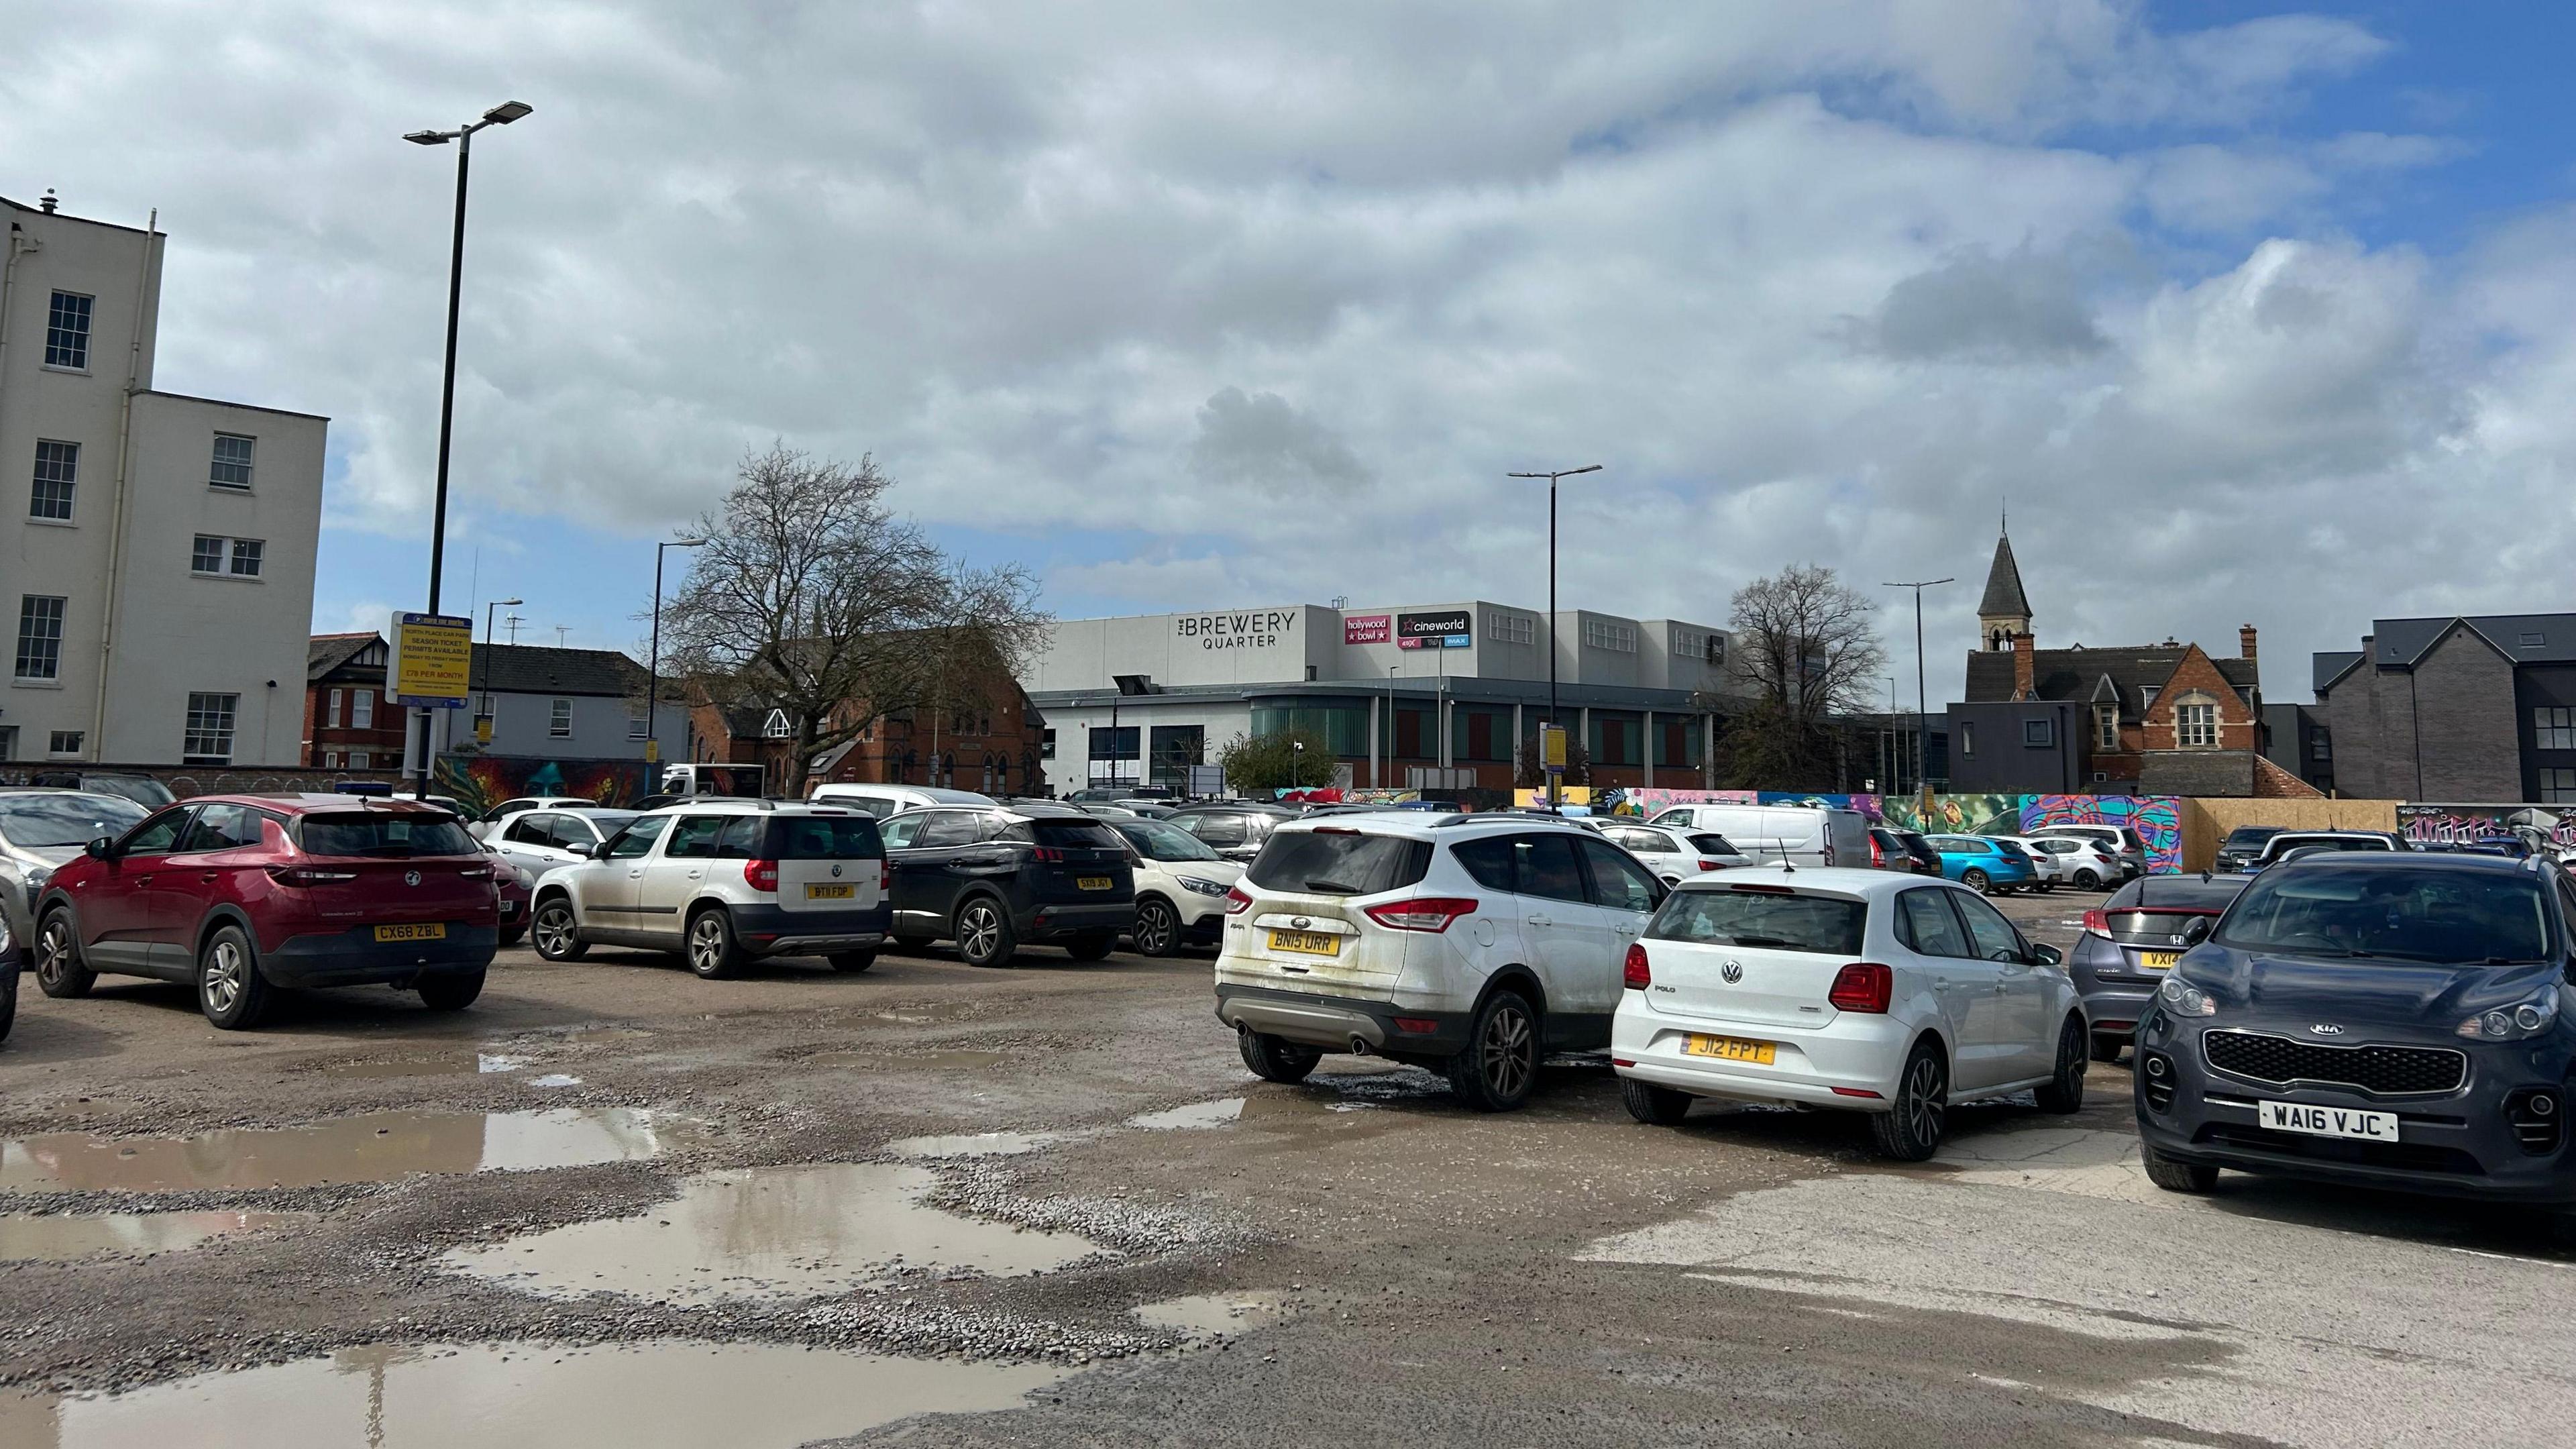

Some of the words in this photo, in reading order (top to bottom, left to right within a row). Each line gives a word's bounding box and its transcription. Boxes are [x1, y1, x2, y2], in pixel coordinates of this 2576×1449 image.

[1185, 612, 1295, 636] BREWERY
[1348, 619, 1386, 631] hollywood
[1414, 619, 1464, 632] cineworld
[1203, 635, 1276, 649] QUARTER
[1357, 631, 1376, 640] bowl
[404, 645, 432, 653] PERMITS
[433, 647, 469, 655] AVAILABLE
[437, 672, 464, 680] MONTH
[380, 926, 414, 938] CX68
[416, 925, 441, 937] ZBL
[1275, 932, 1303, 948] BN15
[1305, 935, 1331, 951] URR
[1654, 985, 1676, 993] POLO
[2315, 1024, 2339, 1033] KIA
[1699, 1037, 1725, 1055] J12
[1728, 1040, 1763, 1060] FPT
[2273, 1106, 2326, 1130] WA16
[2334, 1112, 2381, 1136] VJC
